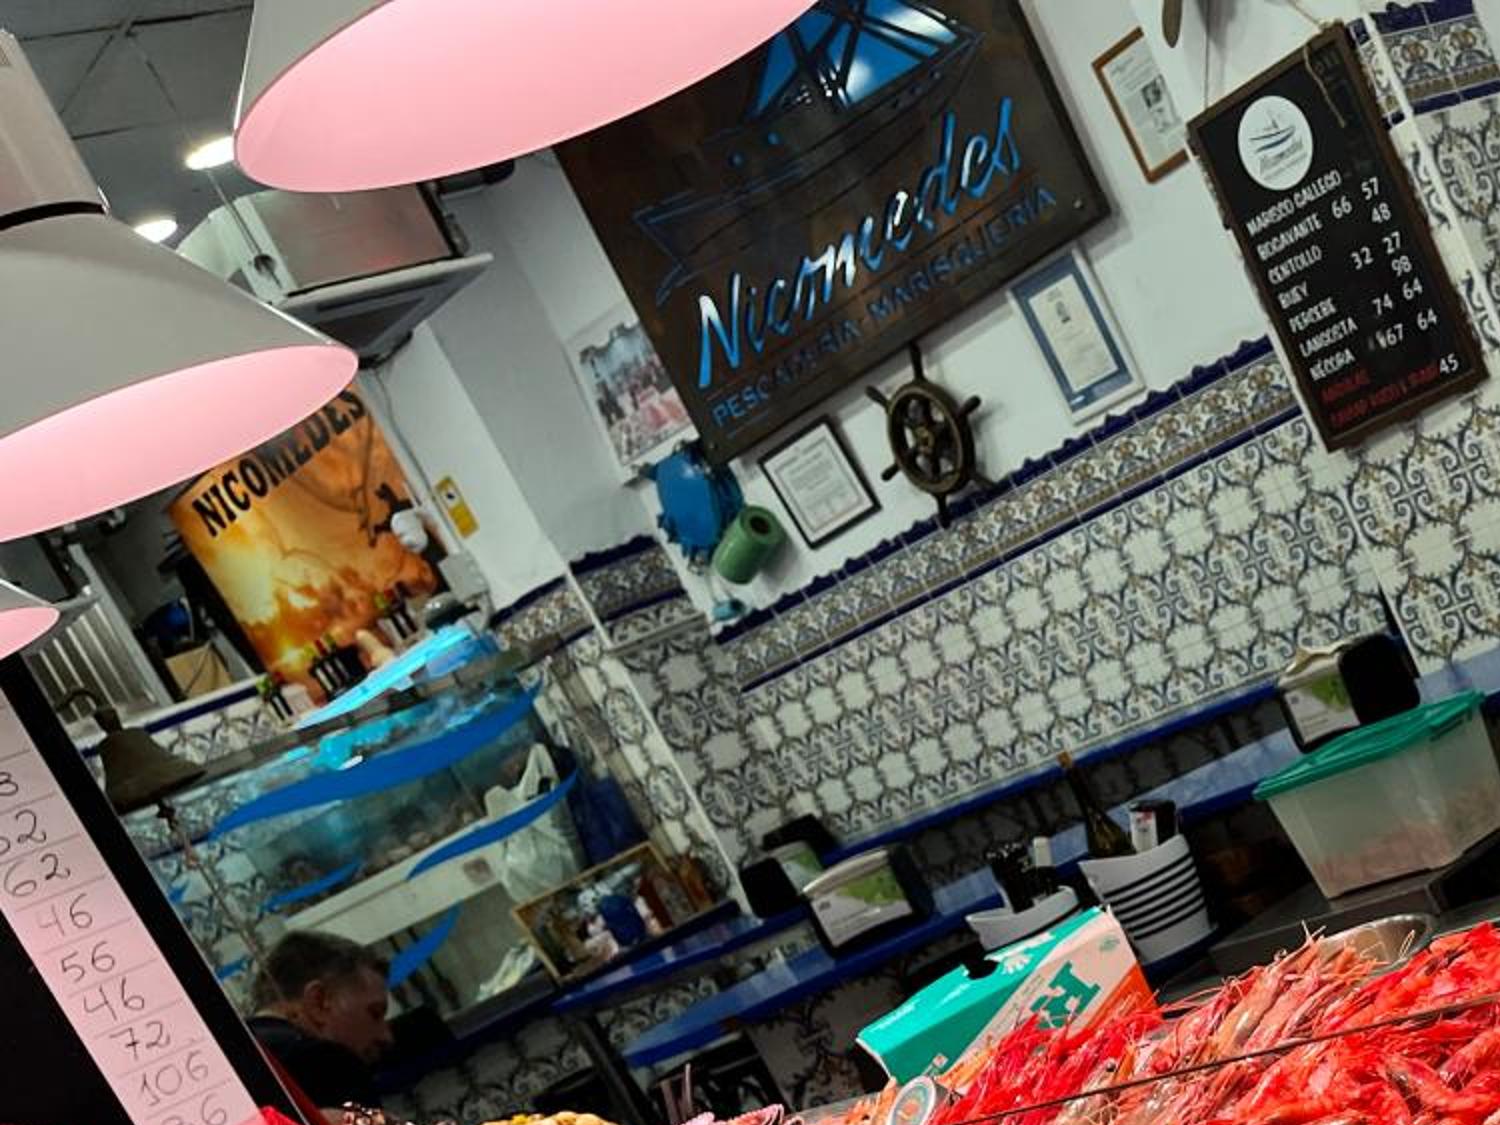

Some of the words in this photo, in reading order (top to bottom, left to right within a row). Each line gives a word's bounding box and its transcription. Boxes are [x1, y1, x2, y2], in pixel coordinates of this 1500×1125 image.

[1246, 198, 1295, 236] MARISCO
[1293, 169, 1342, 208] GALLEGO
[1257, 213, 1322, 260] BOGAVANTE
[1332, 196, 1352, 219] 66
[1361, 176, 1379, 200] 57
[699, 97, 1020, 388] Nicomedes
[1268, 245, 1322, 284] CENTOLLO
[1372, 202, 1391, 223] 48
[1278, 281, 1309, 309] BUEY
[1351, 246, 1374, 270] 32
[1382, 231, 1400, 254] 27
[1289, 297, 1337, 333] PERCEBE
[1392, 255, 1412, 277] 98
[1300, 317, 1358, 357] LANGOSTA
[1372, 293, 1393, 316] 74
[1403, 277, 1423, 300] 64
[1417, 308, 1437, 330] 64
[1439, 353, 1458, 374] 45
[4, 853, 71, 897] 62
[39, 893, 93, 936] 46
[61, 941, 116, 982] 56
[84, 978, 145, 1021] 46
[108, 1021, 170, 1060] 72
[141, 1050, 209, 1107] 106
